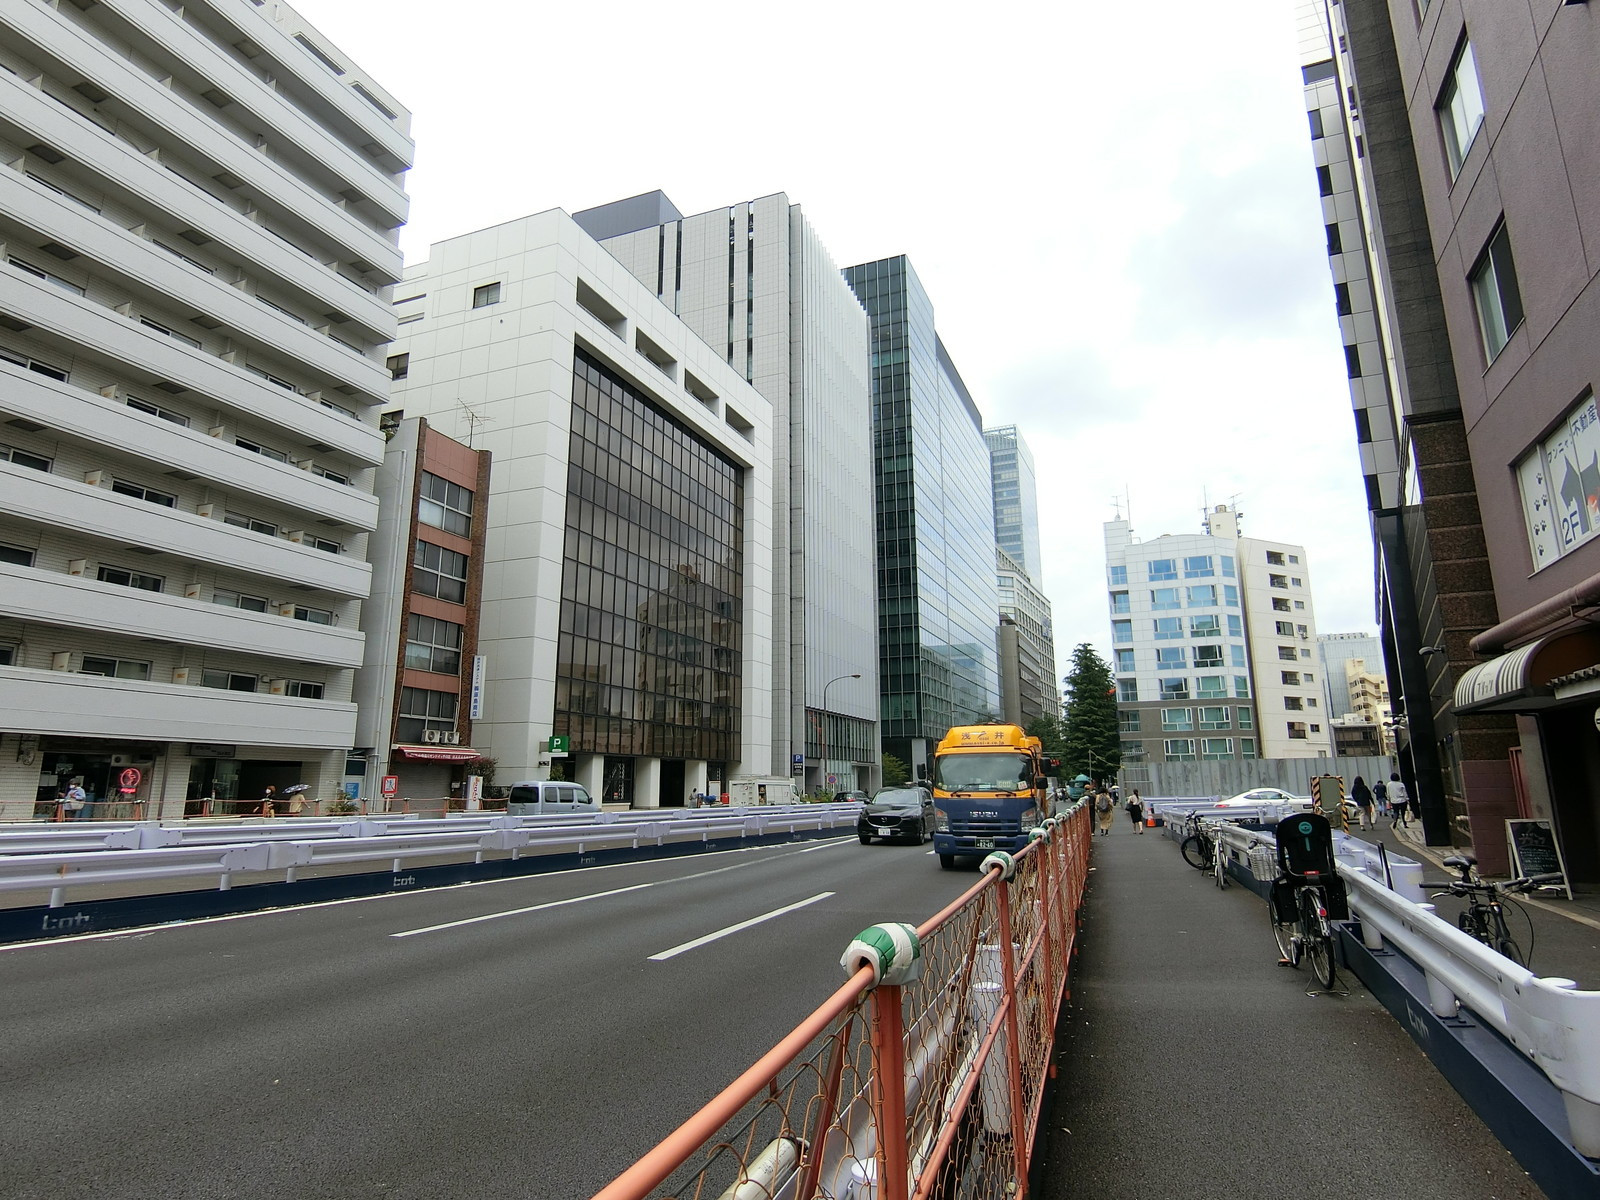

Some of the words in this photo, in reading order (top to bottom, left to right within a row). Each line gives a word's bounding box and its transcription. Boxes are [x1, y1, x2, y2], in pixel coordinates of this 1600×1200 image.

[1562, 510, 1580, 546] 2F
[553, 738, 561, 748] P
[795, 754, 801, 762] P
